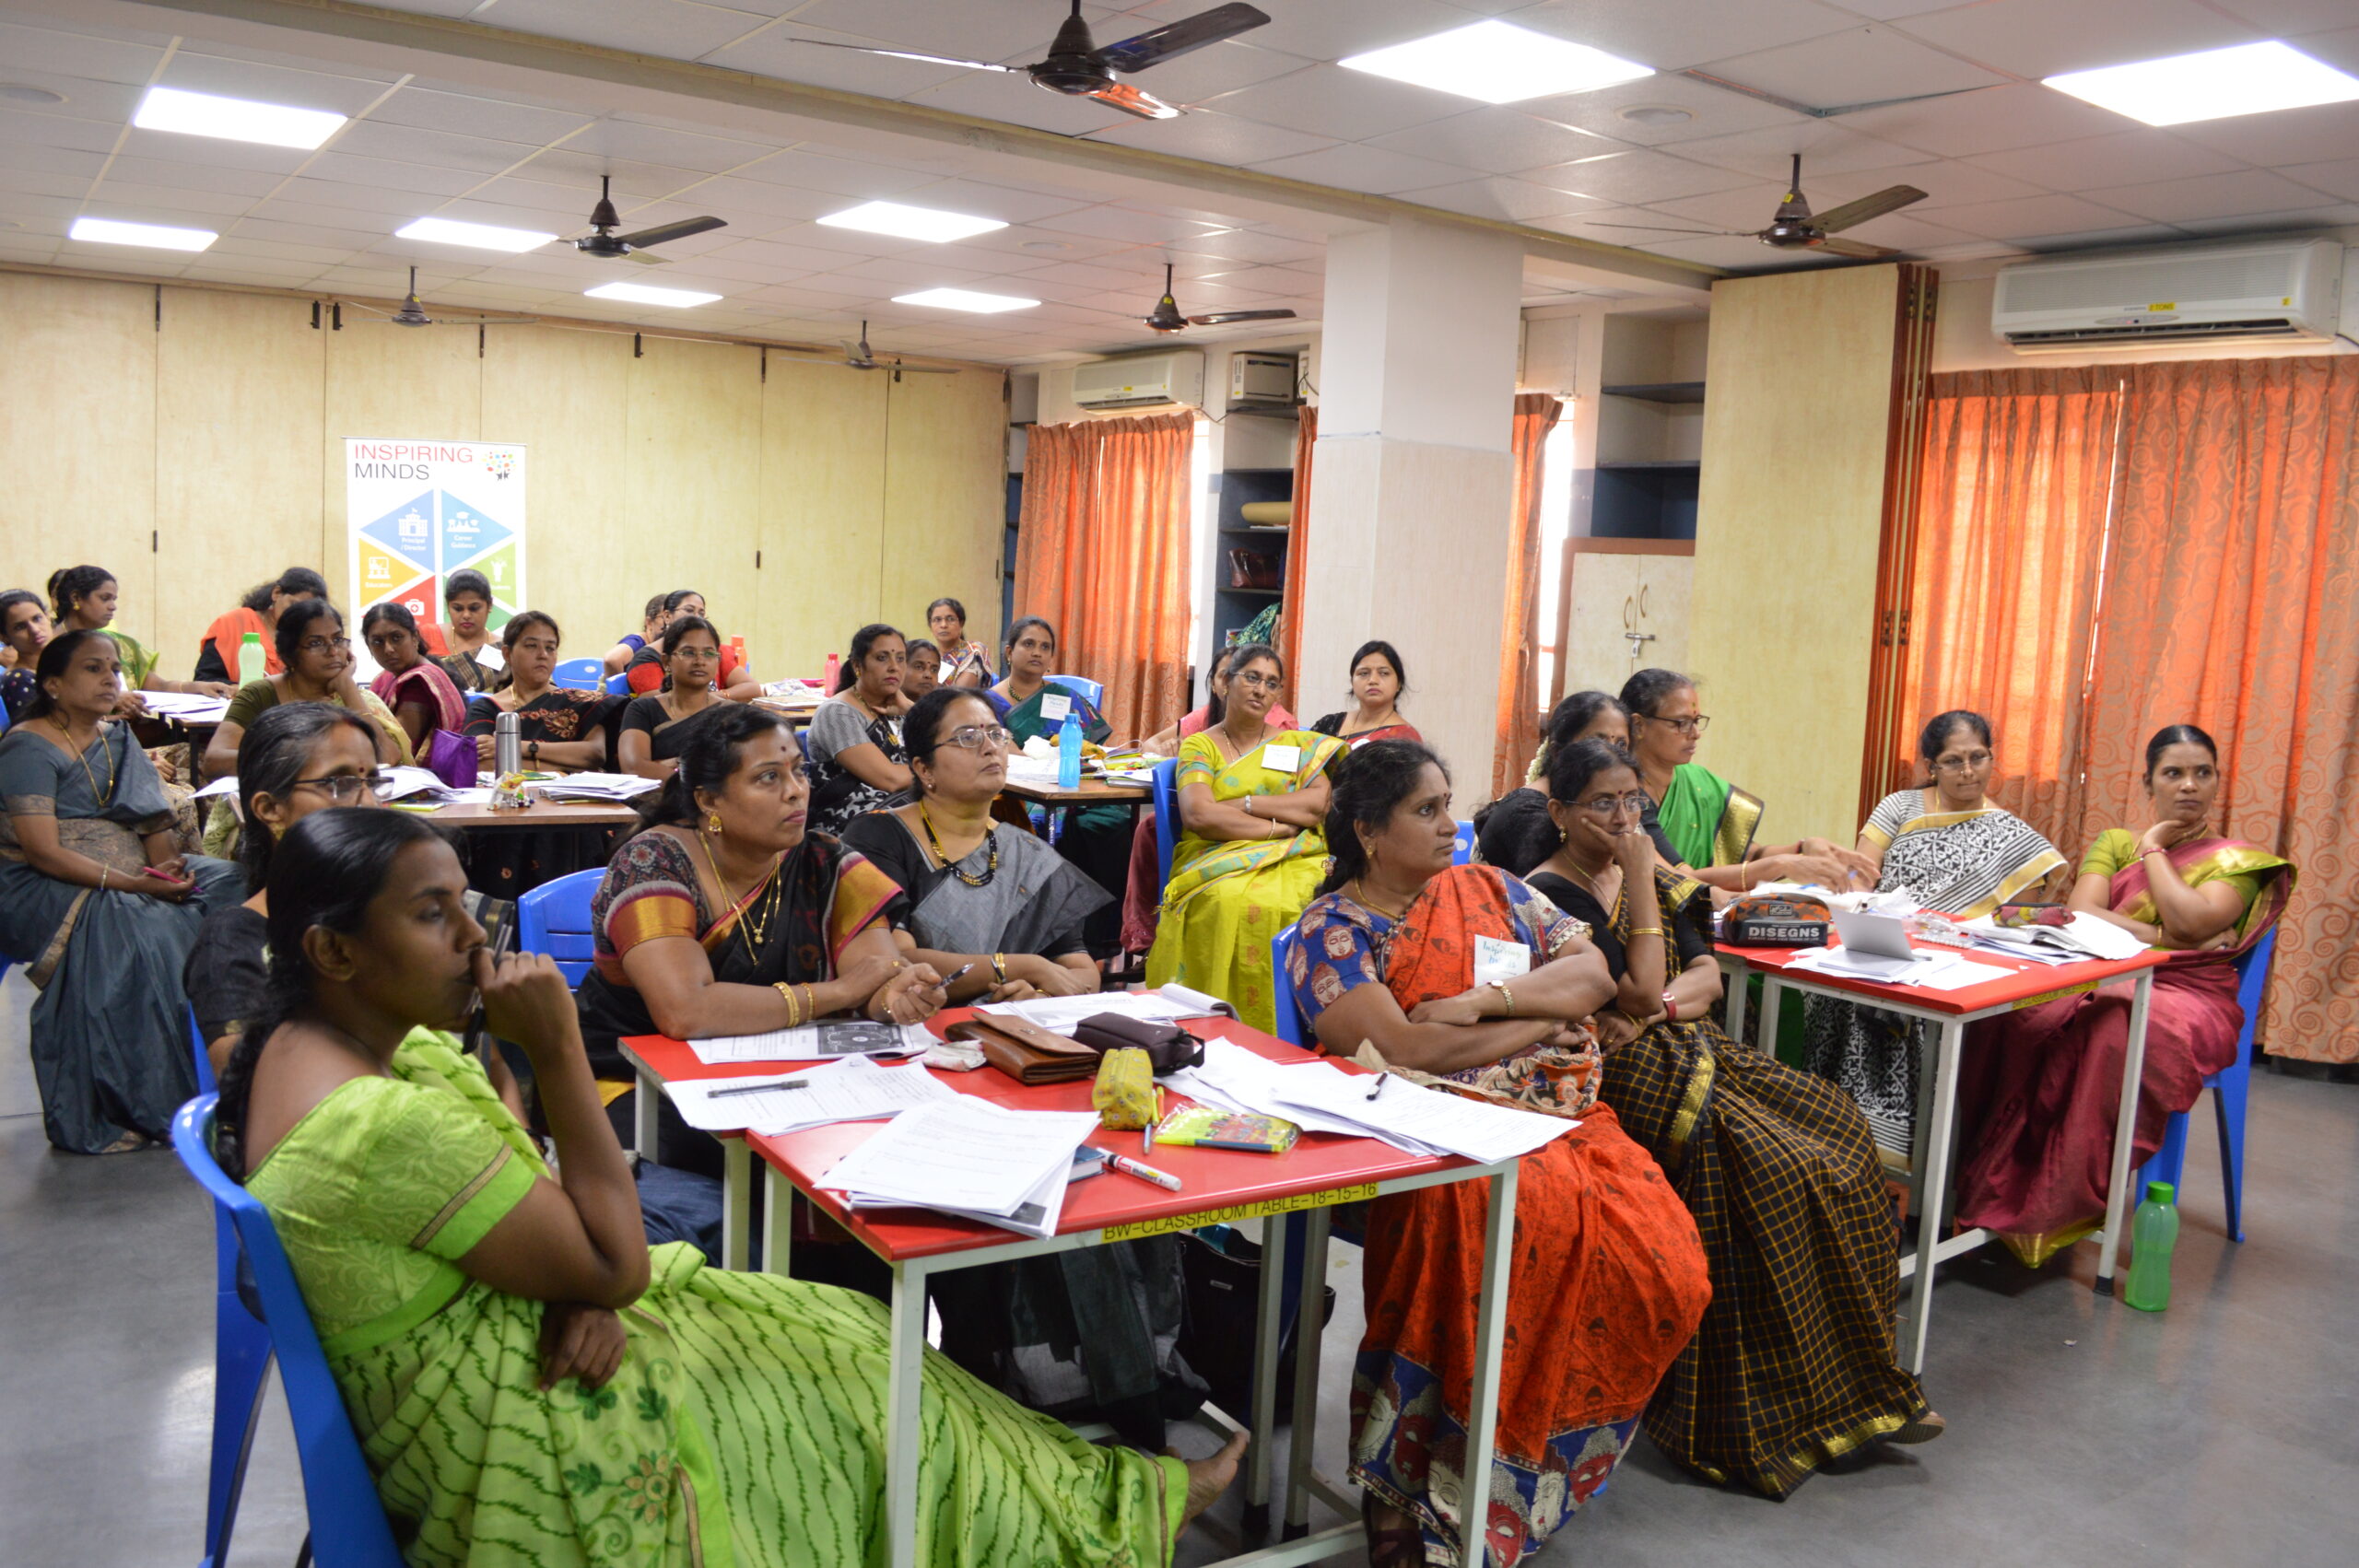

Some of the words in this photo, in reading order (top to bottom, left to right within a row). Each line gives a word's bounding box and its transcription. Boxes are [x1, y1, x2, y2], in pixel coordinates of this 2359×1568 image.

[355, 443, 473, 463] INSPIRING
[355, 462, 429, 480] MINDS
[1749, 927, 1819, 937] DISEGNS
[1104, 1205, 1247, 1240] BW-CLASSROOM
[1251, 1182, 1378, 1215] TABLE-18-15-16
